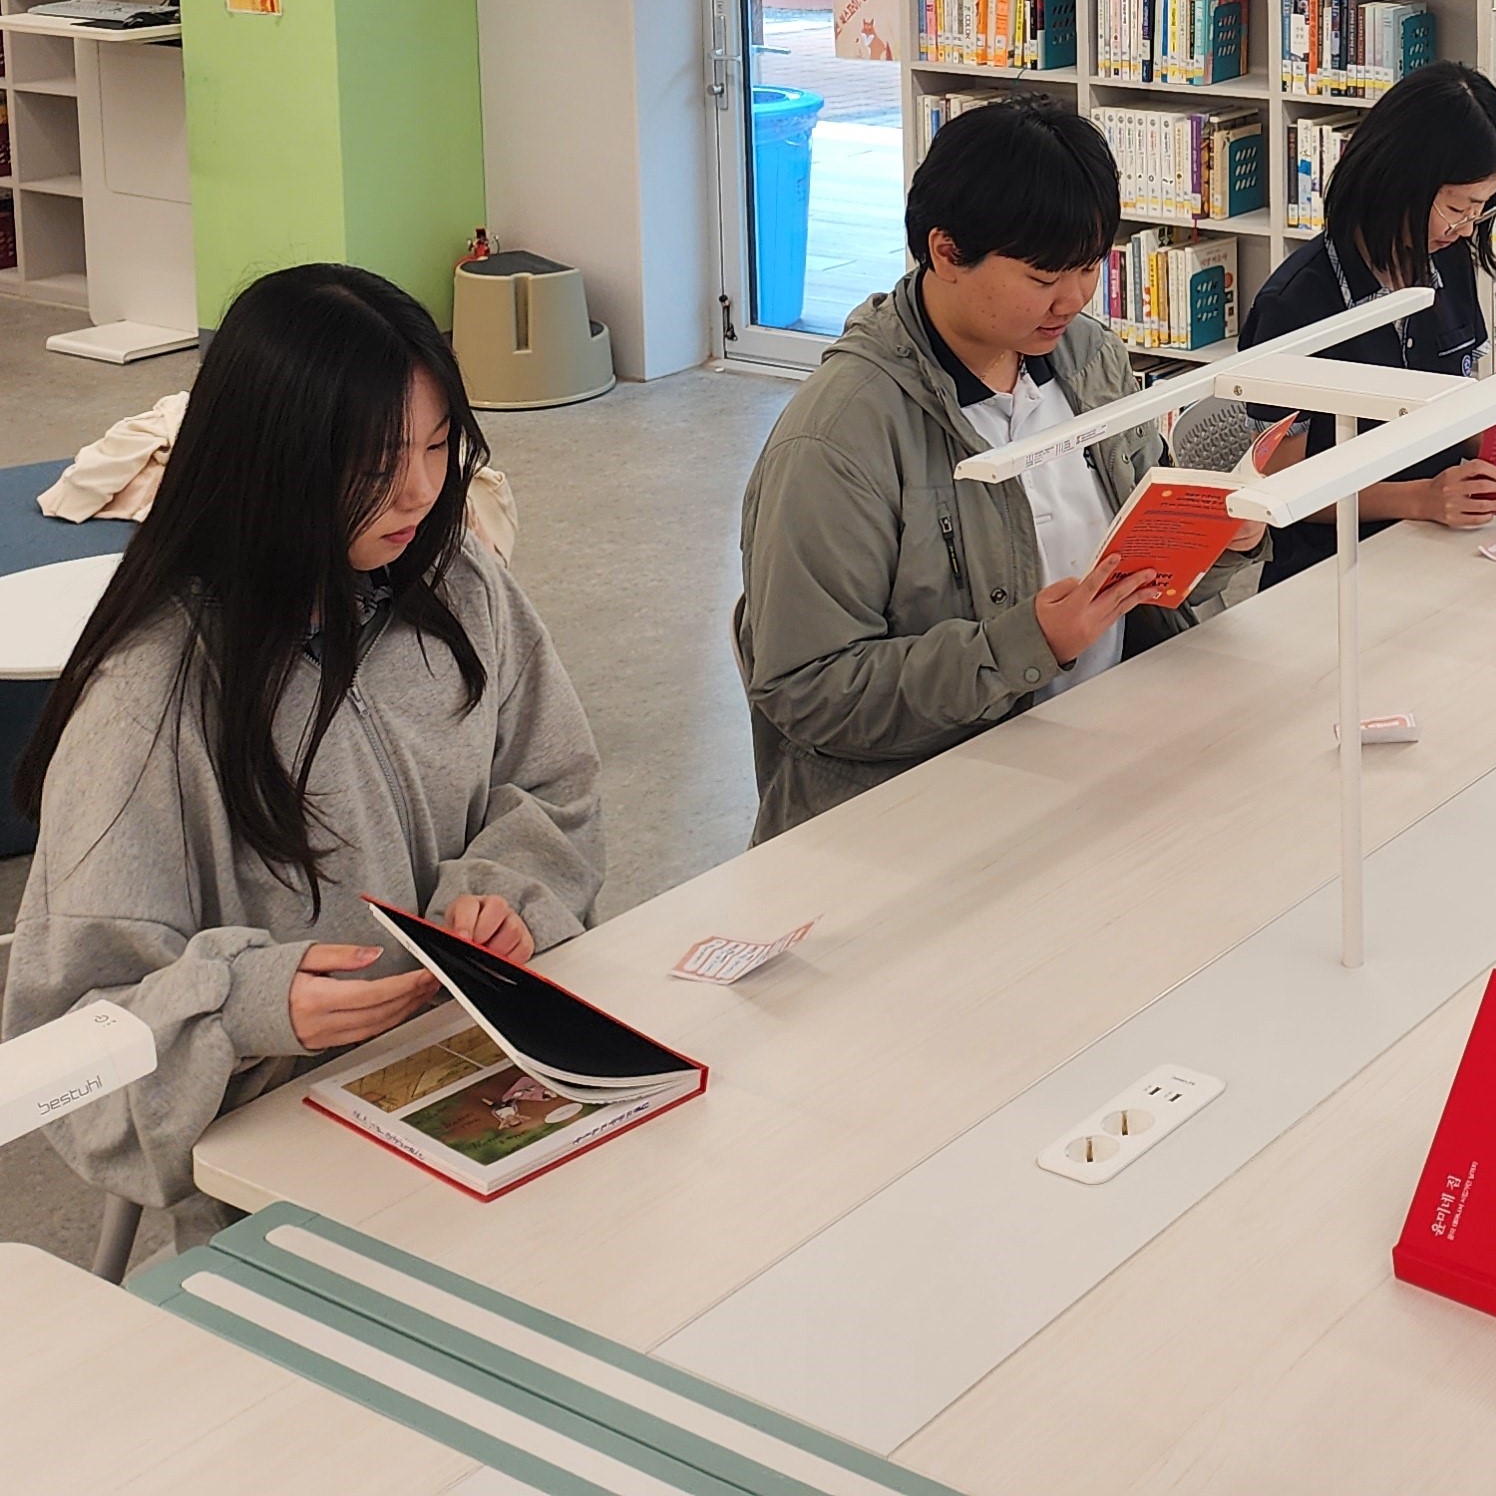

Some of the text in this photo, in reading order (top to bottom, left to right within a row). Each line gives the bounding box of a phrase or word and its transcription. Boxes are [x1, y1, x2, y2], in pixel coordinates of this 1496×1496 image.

[37, 1075, 103, 1115] bestuhl
[1430, 1173, 1462, 1237] 윤미네 집
